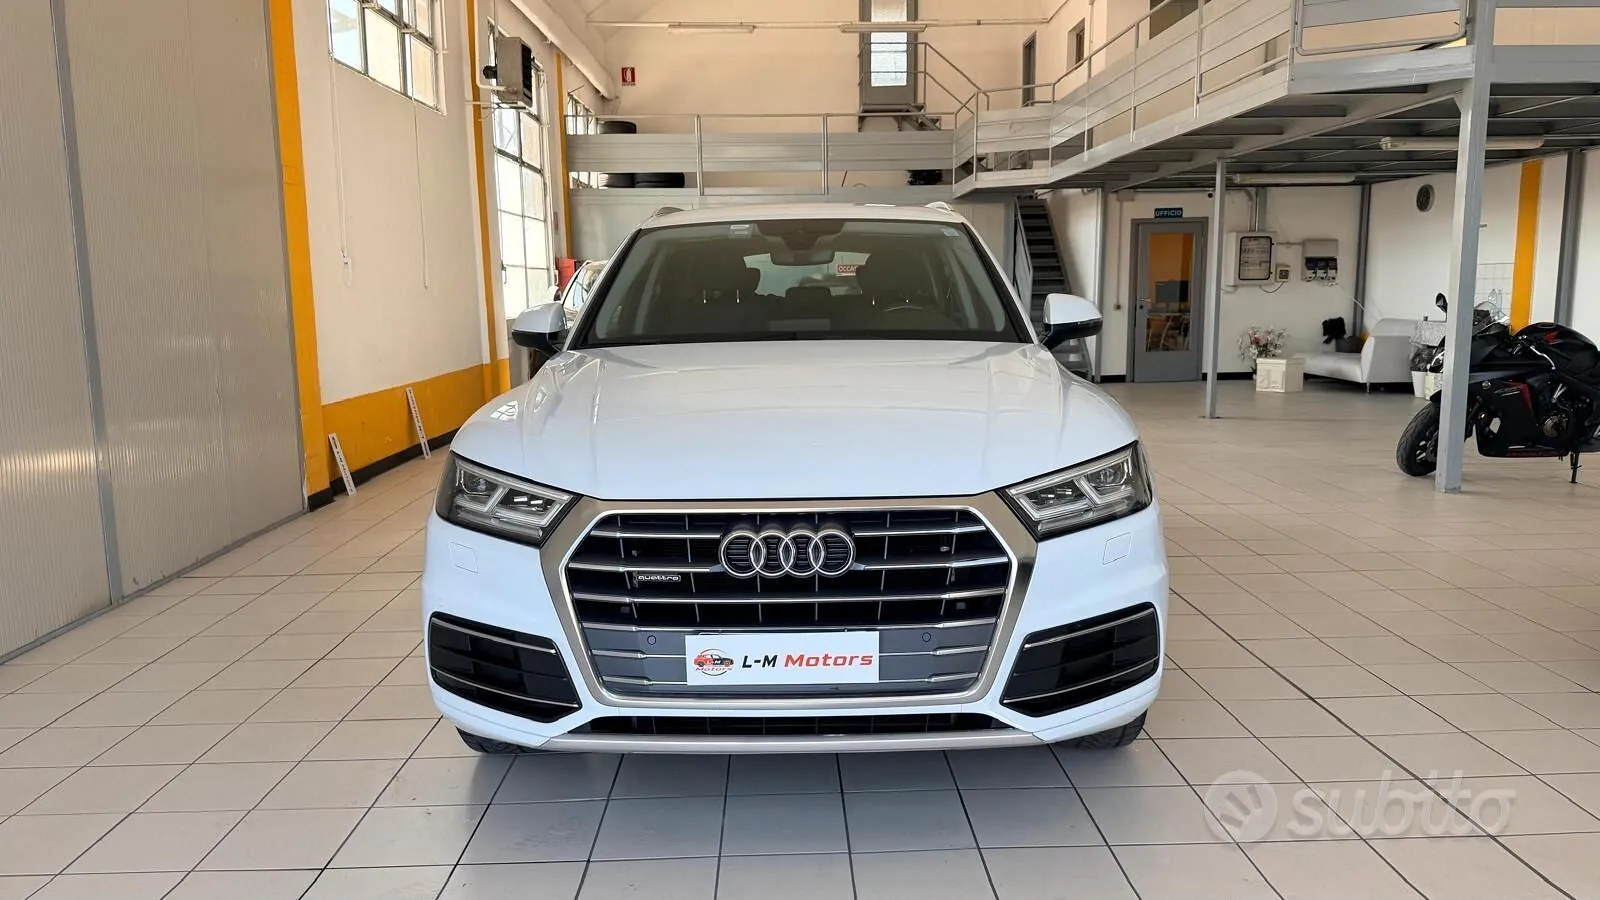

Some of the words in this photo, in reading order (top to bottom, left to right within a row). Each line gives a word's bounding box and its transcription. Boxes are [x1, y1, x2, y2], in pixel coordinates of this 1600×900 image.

[1155, 209, 1182, 217] UFFICIO
[741, 654, 778, 668] L-M
[784, 653, 874, 668] Motors
